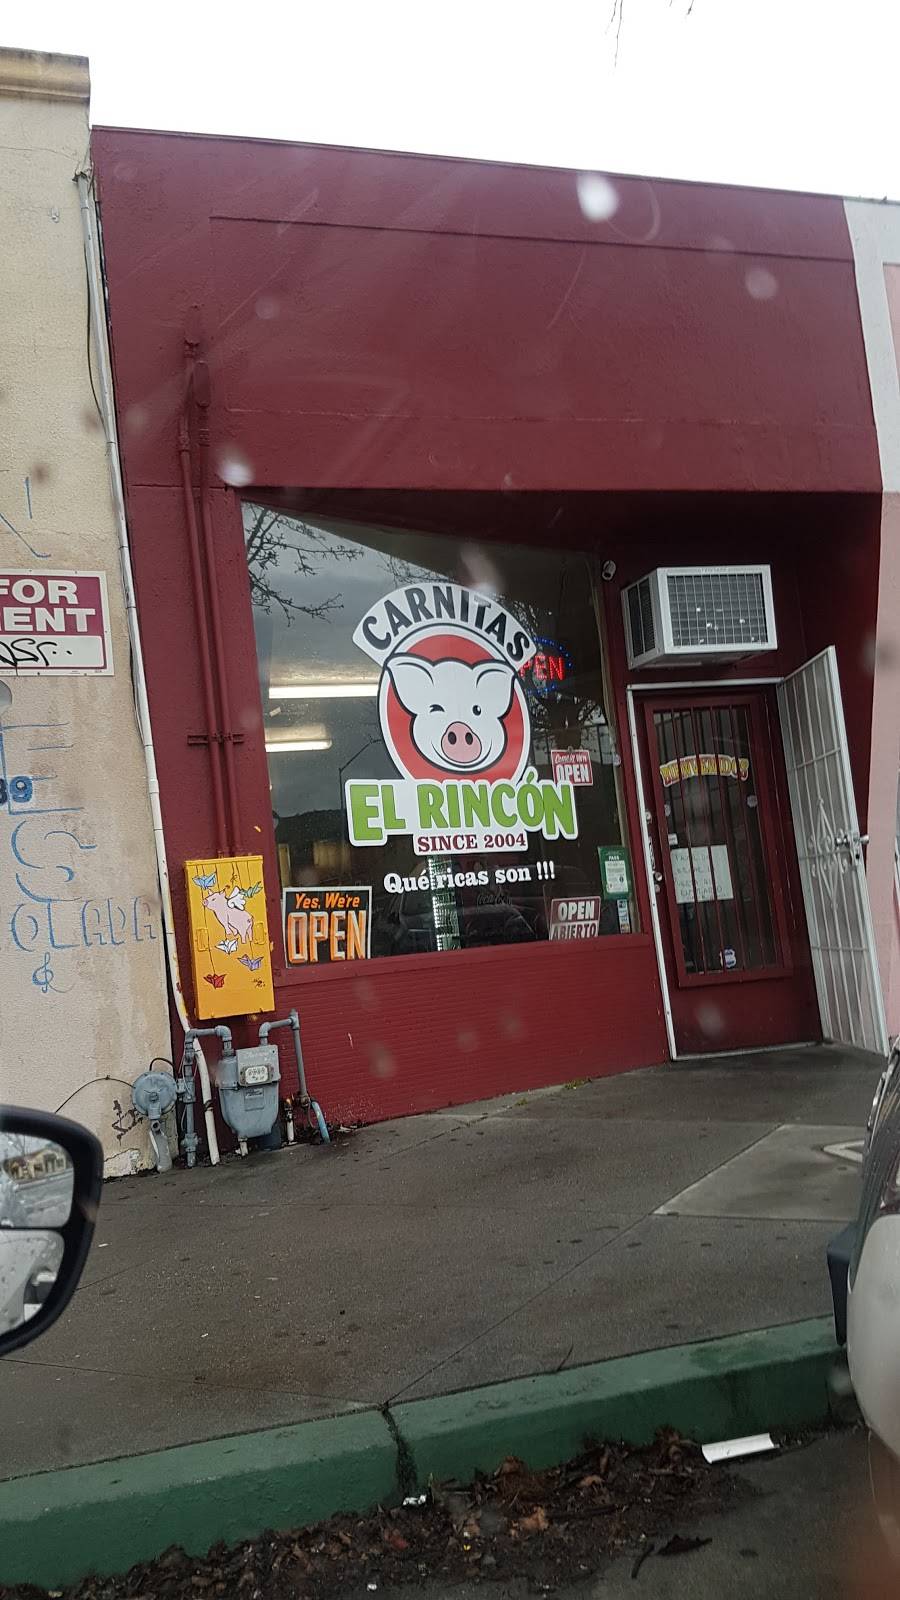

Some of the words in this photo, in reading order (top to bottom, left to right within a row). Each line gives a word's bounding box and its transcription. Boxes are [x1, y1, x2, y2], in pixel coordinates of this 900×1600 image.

[0, 606, 96, 632] ENT
[362, 585, 530, 661] CARNITAS
[518, 654, 565, 681] PEN
[555, 763, 590, 784] OPEN
[350, 784, 406, 841] EL
[416, 771, 575, 835] RINCÓN
[418, 834, 478, 853] SINCE
[484, 833, 527, 849] 2004
[383, 869, 430, 895] Qué
[436, 867, 489, 889] ricas
[495, 866, 532, 885] son
[536, 860, 555, 880] !!!
[325, 892, 360, 909] We're
[558, 900, 595, 921] OPEN
[287, 910, 367, 964] OPEN
[551, 922, 598, 940] ABIERTO
